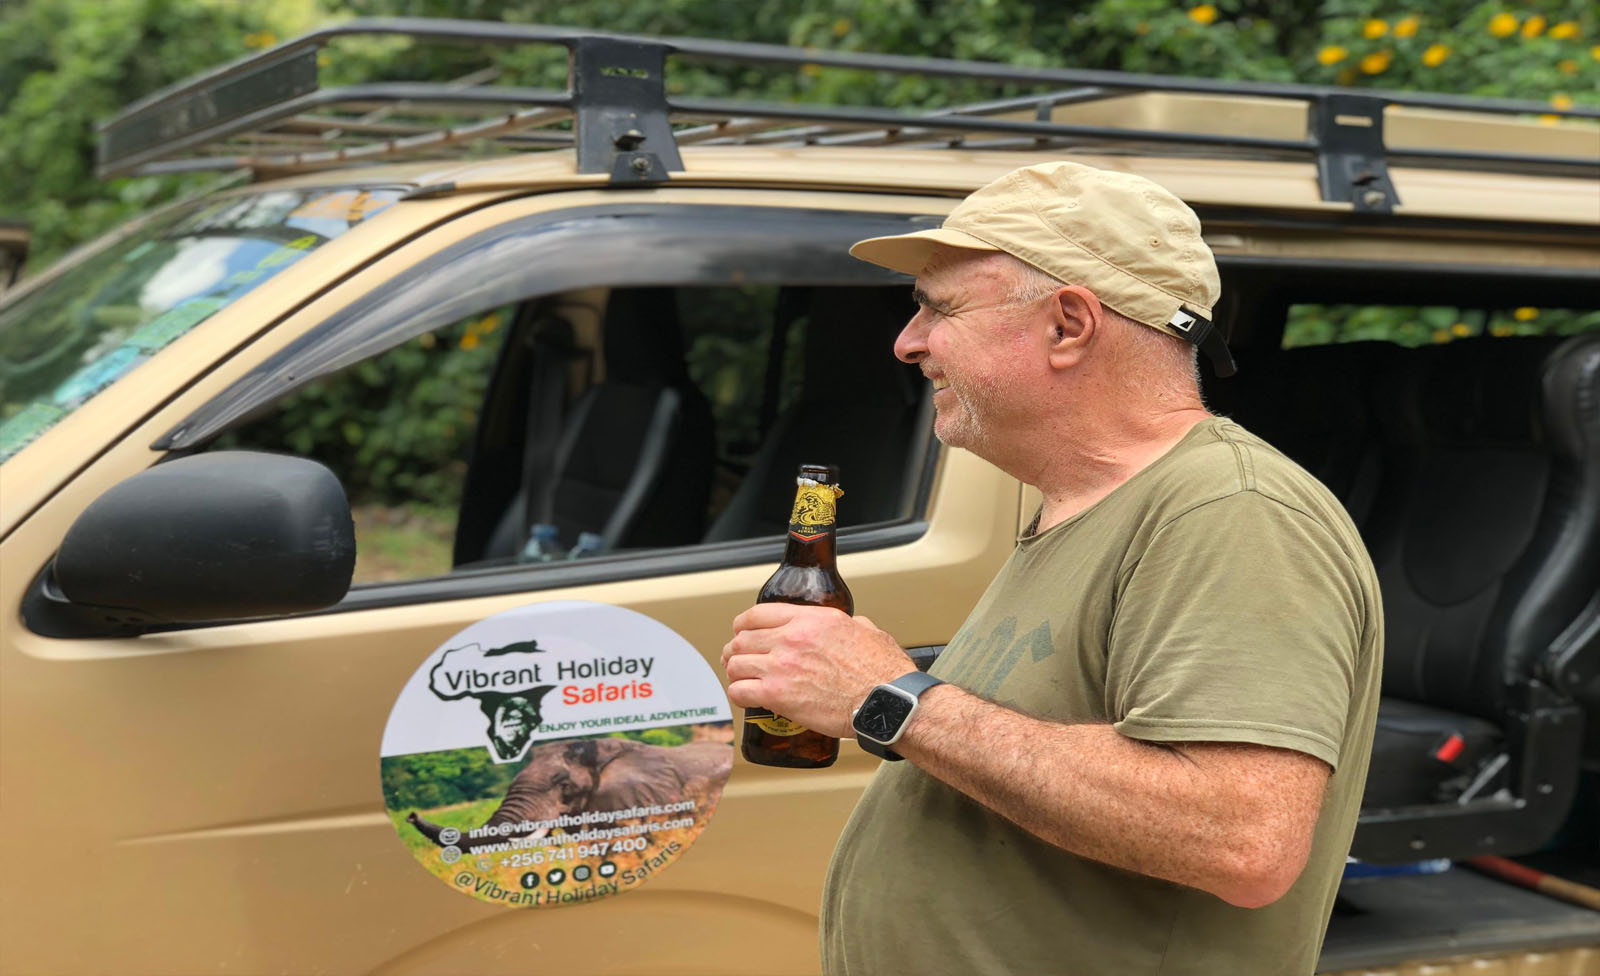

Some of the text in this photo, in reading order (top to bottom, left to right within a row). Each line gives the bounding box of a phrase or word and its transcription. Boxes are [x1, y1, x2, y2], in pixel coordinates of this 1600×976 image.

[445, 656, 654, 690] Vibrant Holiday
[562, 680, 653, 706] Safaris
[538, 706, 718, 733] ENJOY YOUR IDEAL ADVENTURE
[469, 800, 695, 838] info@vibrantholidaysafaris.com
[470, 817, 694, 855] www.vibrantholidaysafaris.com
[501, 838, 647, 868] +256 741 947 400
[455, 839, 681, 905] @Vibrant Holiday Safaris
